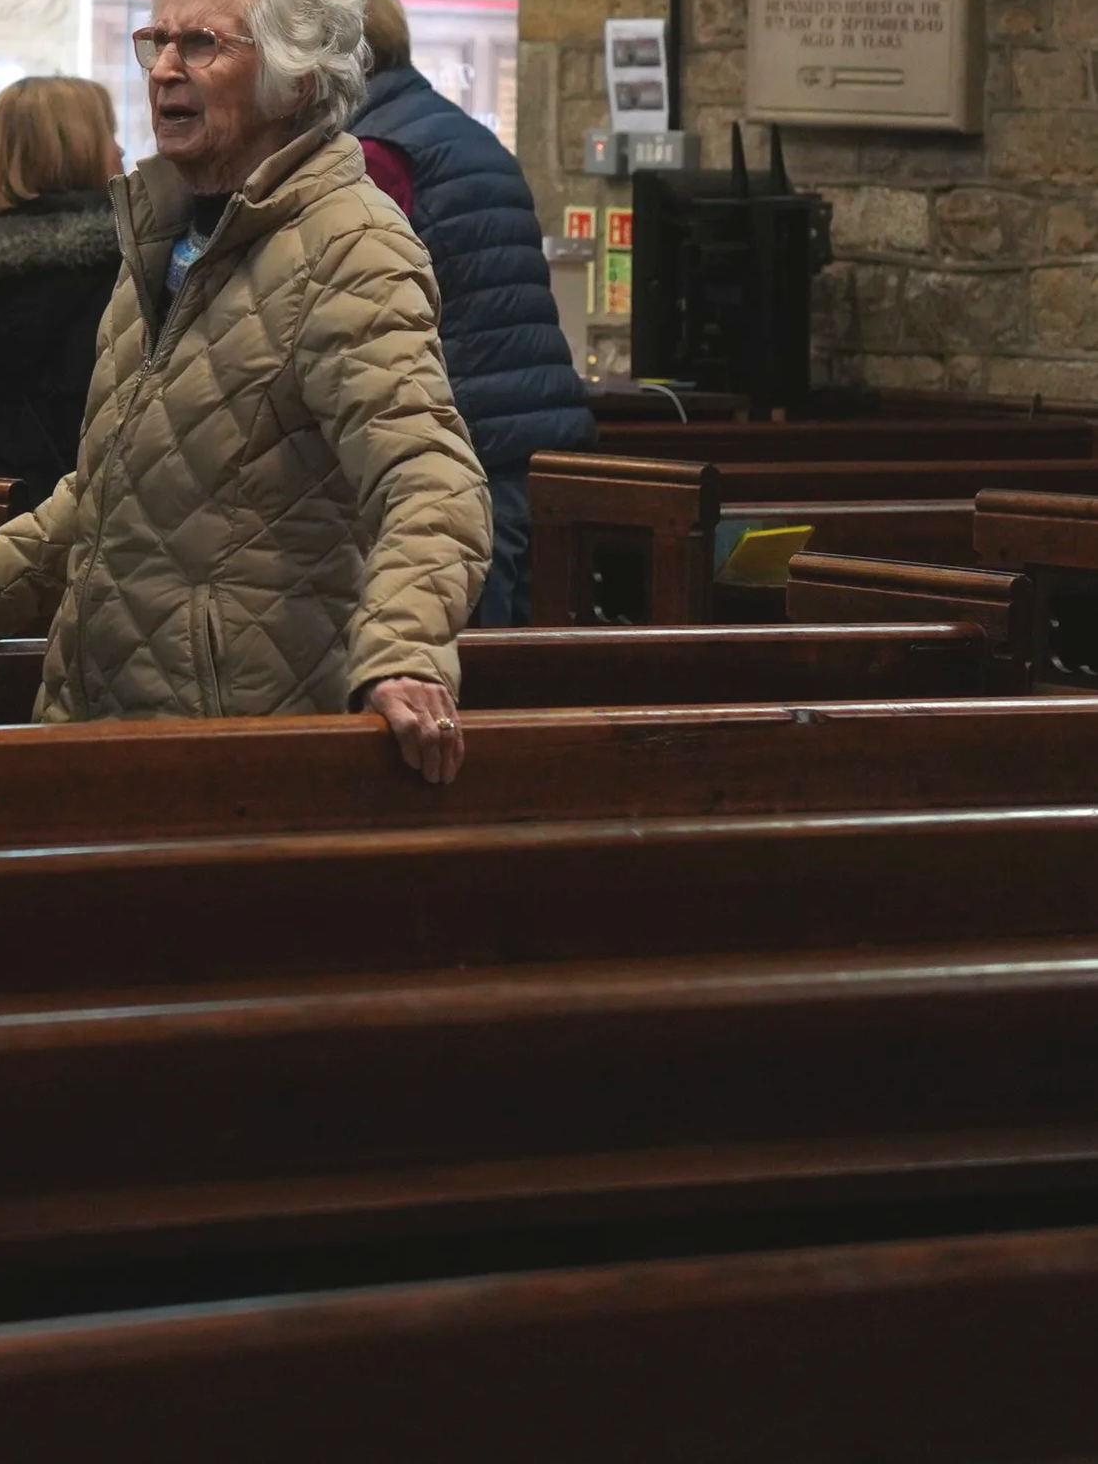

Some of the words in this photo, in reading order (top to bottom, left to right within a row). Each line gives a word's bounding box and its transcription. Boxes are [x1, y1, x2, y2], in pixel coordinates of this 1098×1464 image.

[766, 0, 779, 13] HE
[784, 0, 824, 13] PASSED
[828, 0, 841, 13] TO
[845, 0, 862, 13] HIS
[865, 0, 892, 13] REST
[896, 0, 914, 13] ON
[922, 0, 940, 13] THE
[789, 16, 811, 31] DAY
[820, 16, 834, 31] OF
[842, 16, 908, 31] SEPTEMBER
[801, 35, 834, 48] AGED
